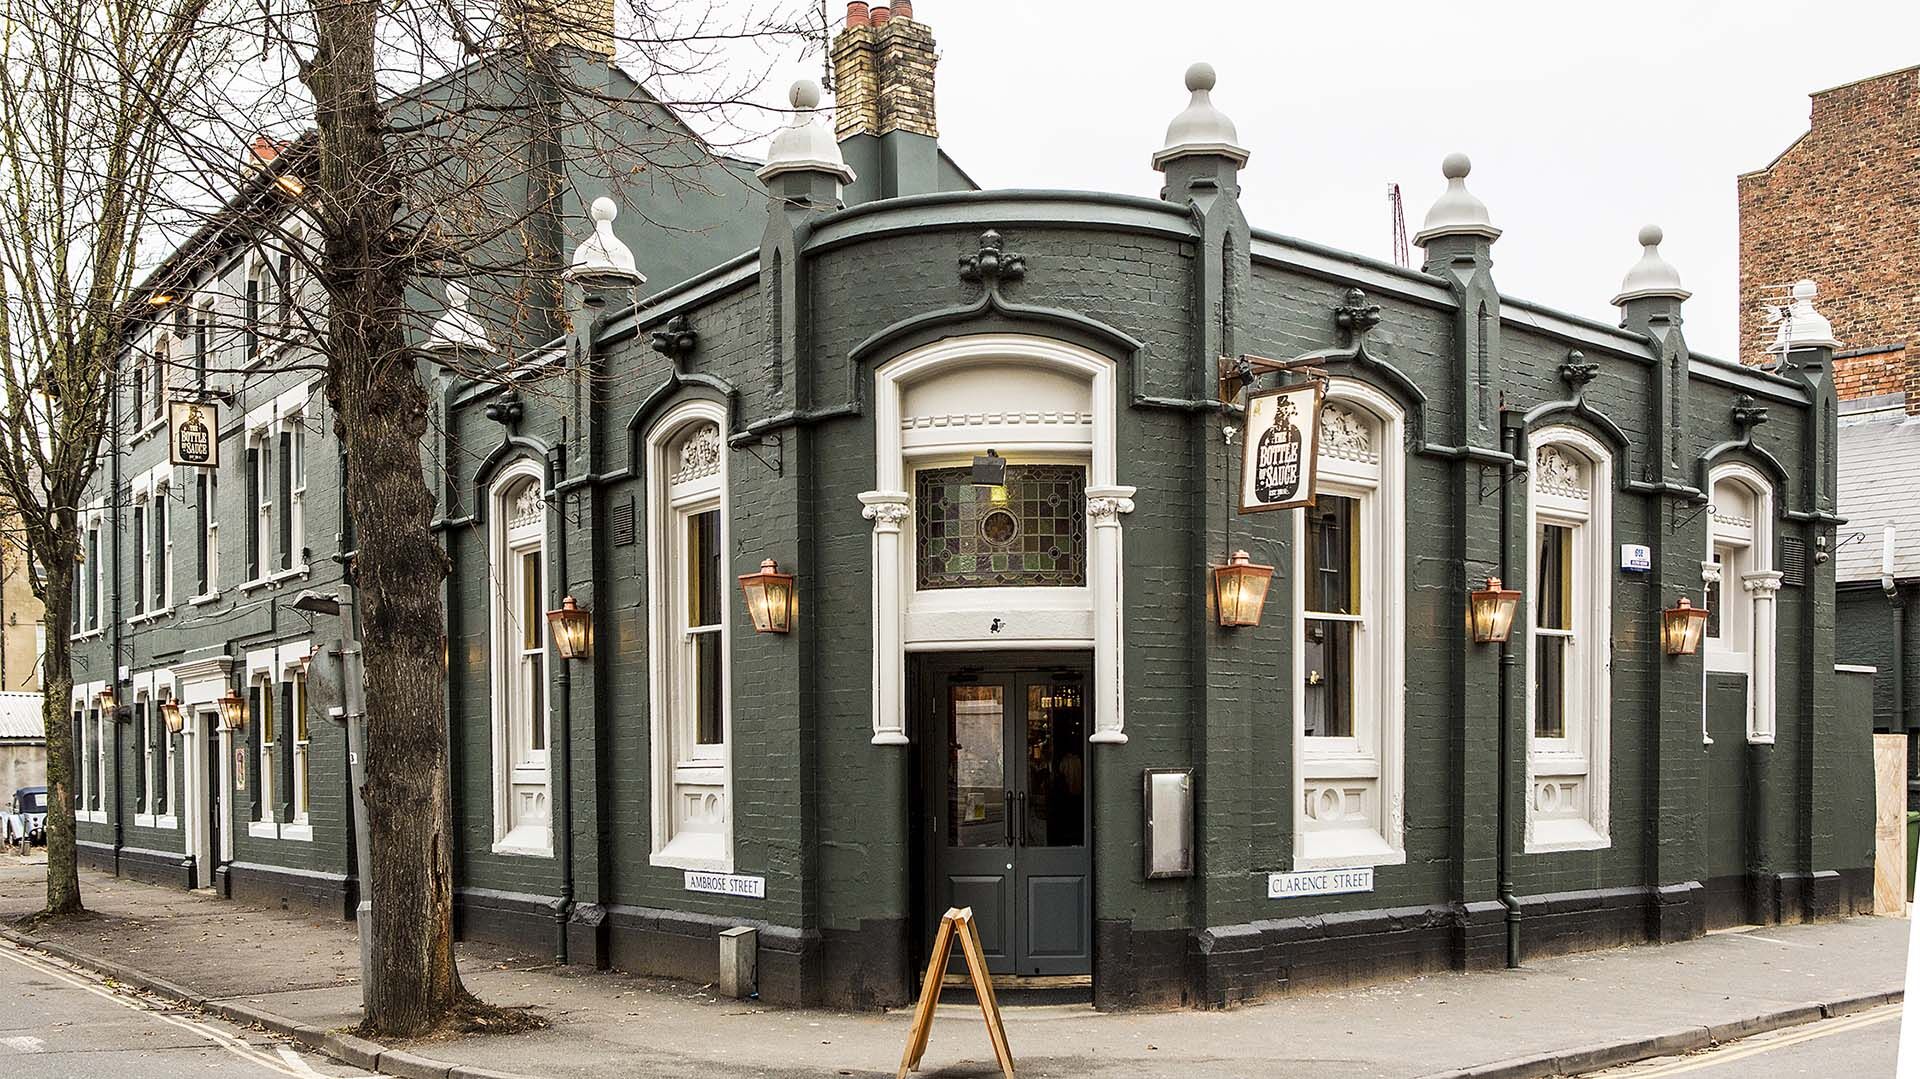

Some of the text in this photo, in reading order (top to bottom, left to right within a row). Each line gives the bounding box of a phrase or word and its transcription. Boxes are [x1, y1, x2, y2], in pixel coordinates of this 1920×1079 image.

[181, 430, 207, 443] BOTTLE
[1274, 431, 1288, 443] THE
[1259, 442, 1299, 467] BOTTLE
[1265, 463, 1298, 487] SAUCE
[690, 876, 759, 894] AMBROSE STREET
[1272, 872, 1370, 893] CLARENCE STREET
